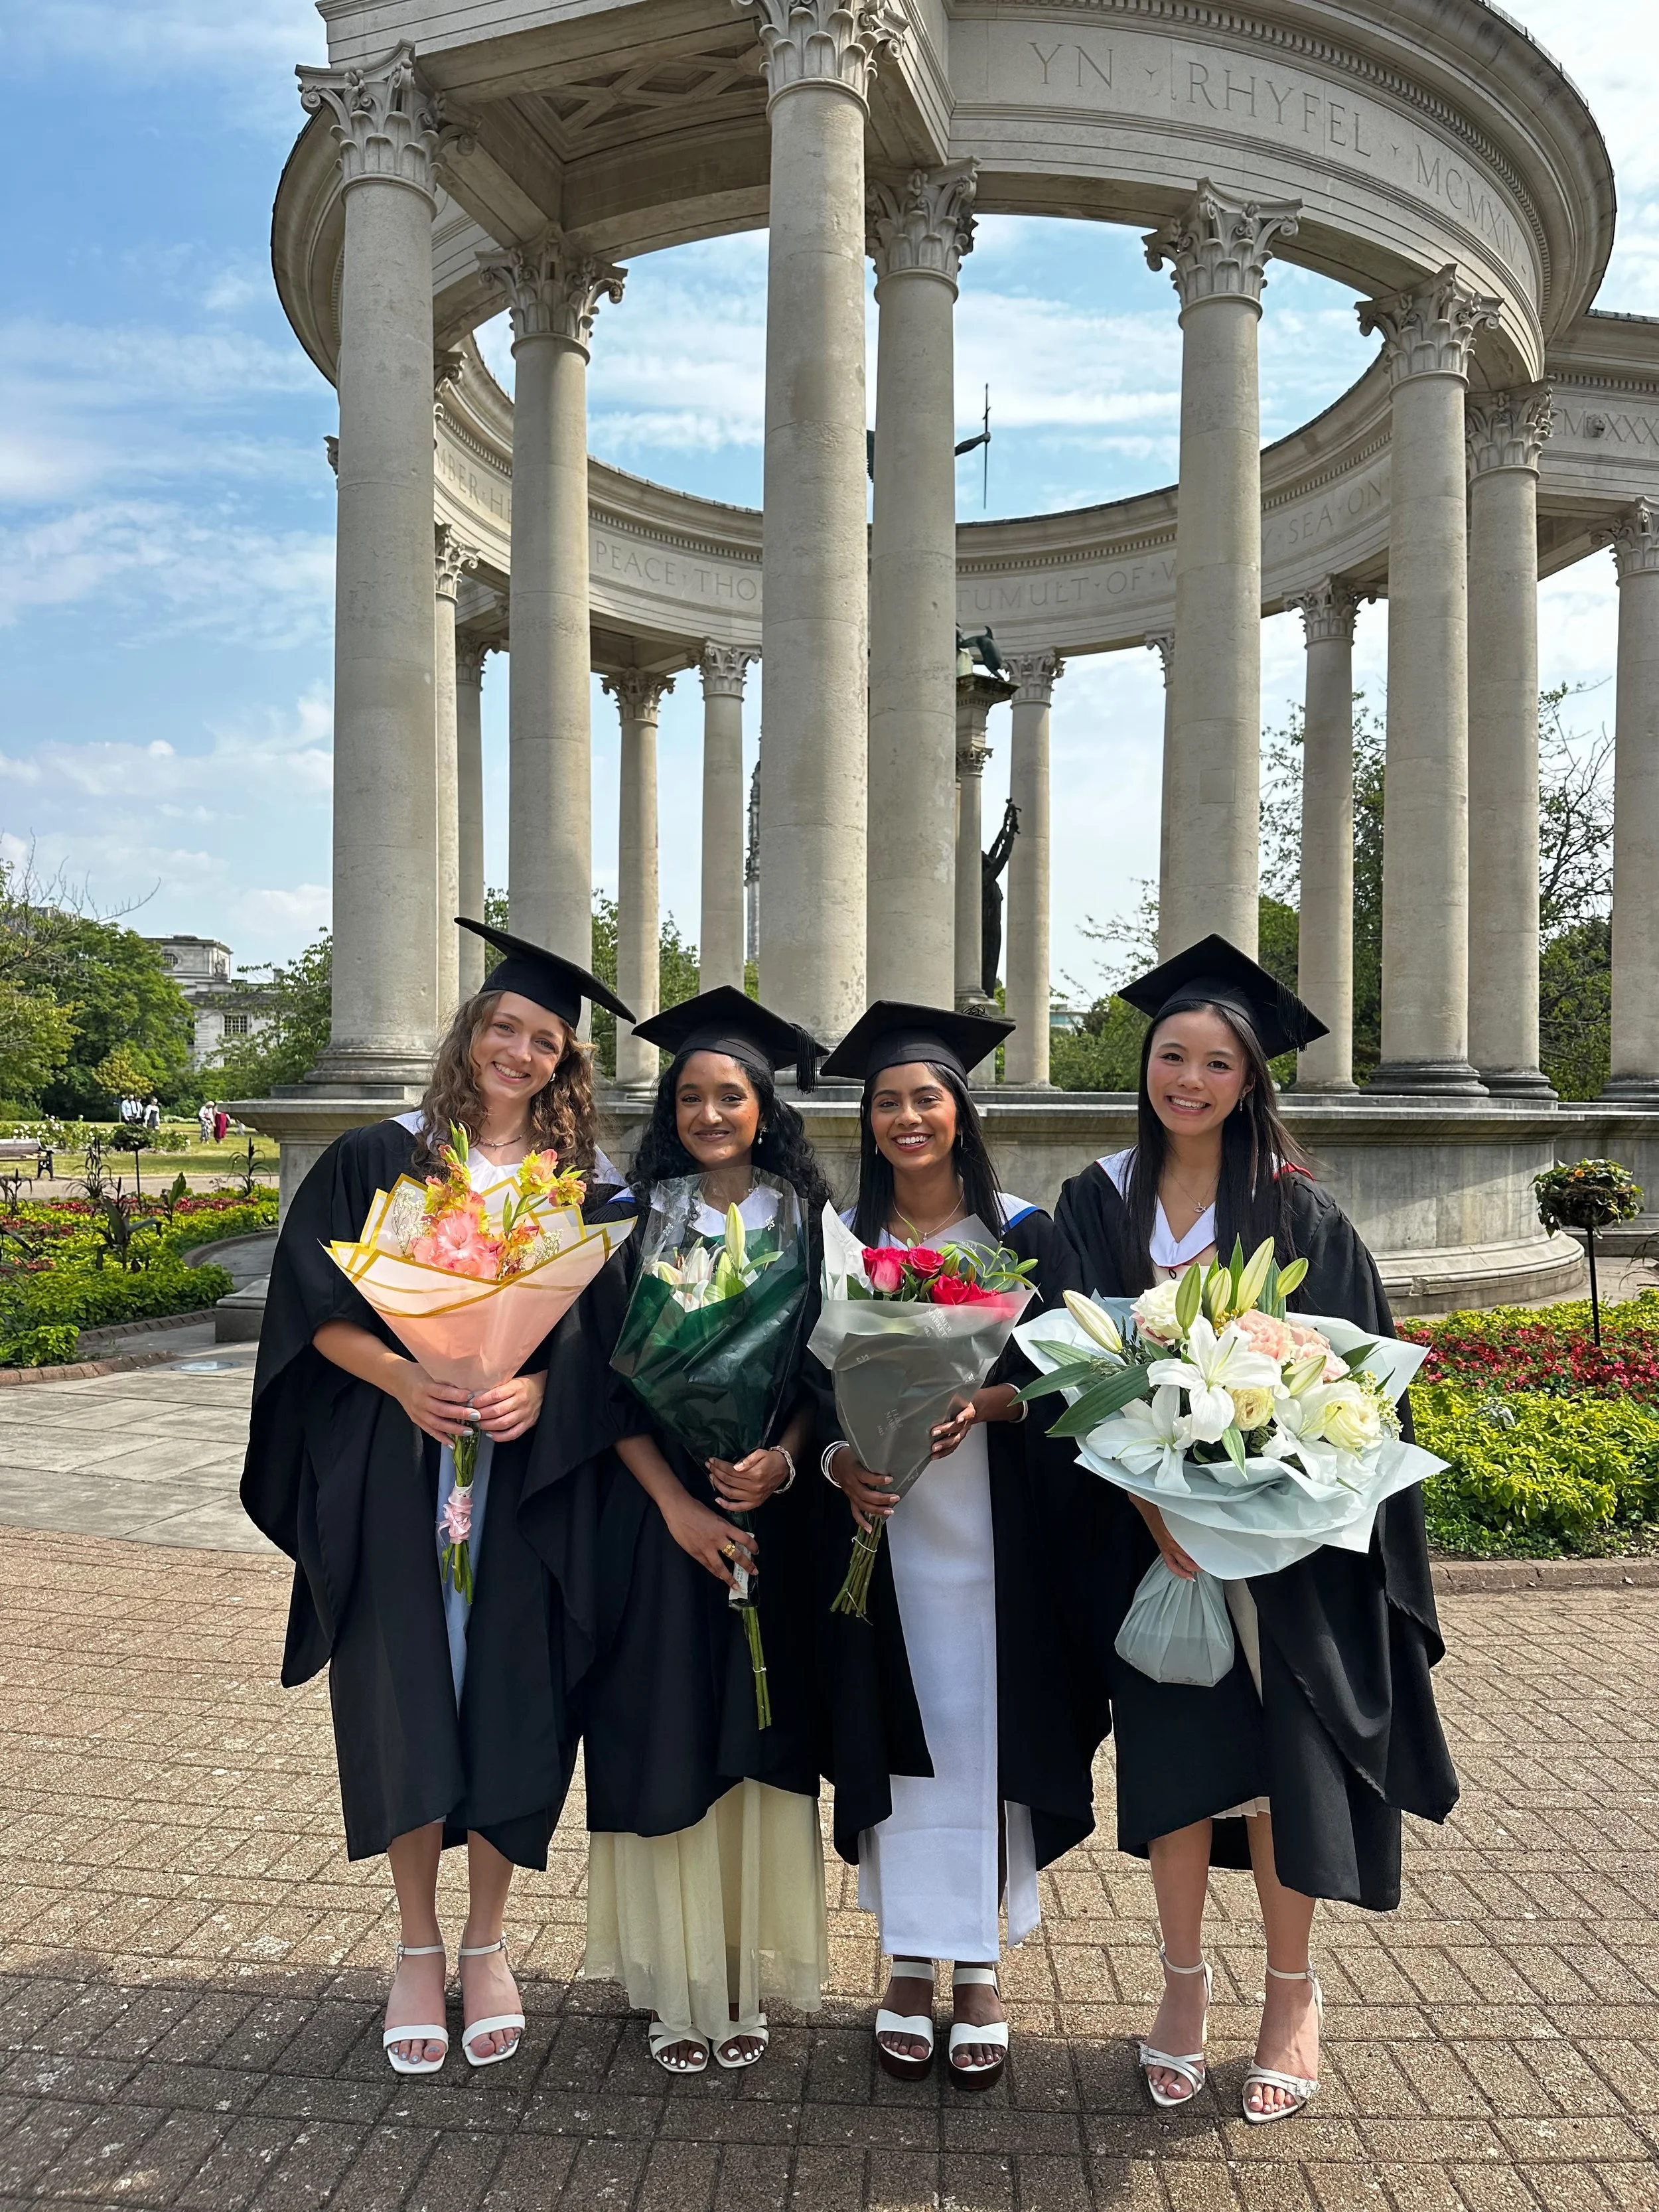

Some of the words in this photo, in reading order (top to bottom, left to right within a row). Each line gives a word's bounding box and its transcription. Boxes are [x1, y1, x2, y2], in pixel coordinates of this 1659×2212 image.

[1027, 41, 1115, 90] YN
[1187, 61, 1372, 157] RHYFEL
[1415, 143, 1518, 264] MCMXIV
[1287, 503, 1334, 545] SEA
[1347, 473, 1384, 515] ON
[595, 540, 676, 586] PEACE
[693, 568, 762, 602] THO
[956, 576, 1090, 612] TUMULT
[1106, 566, 1145, 594] OF
